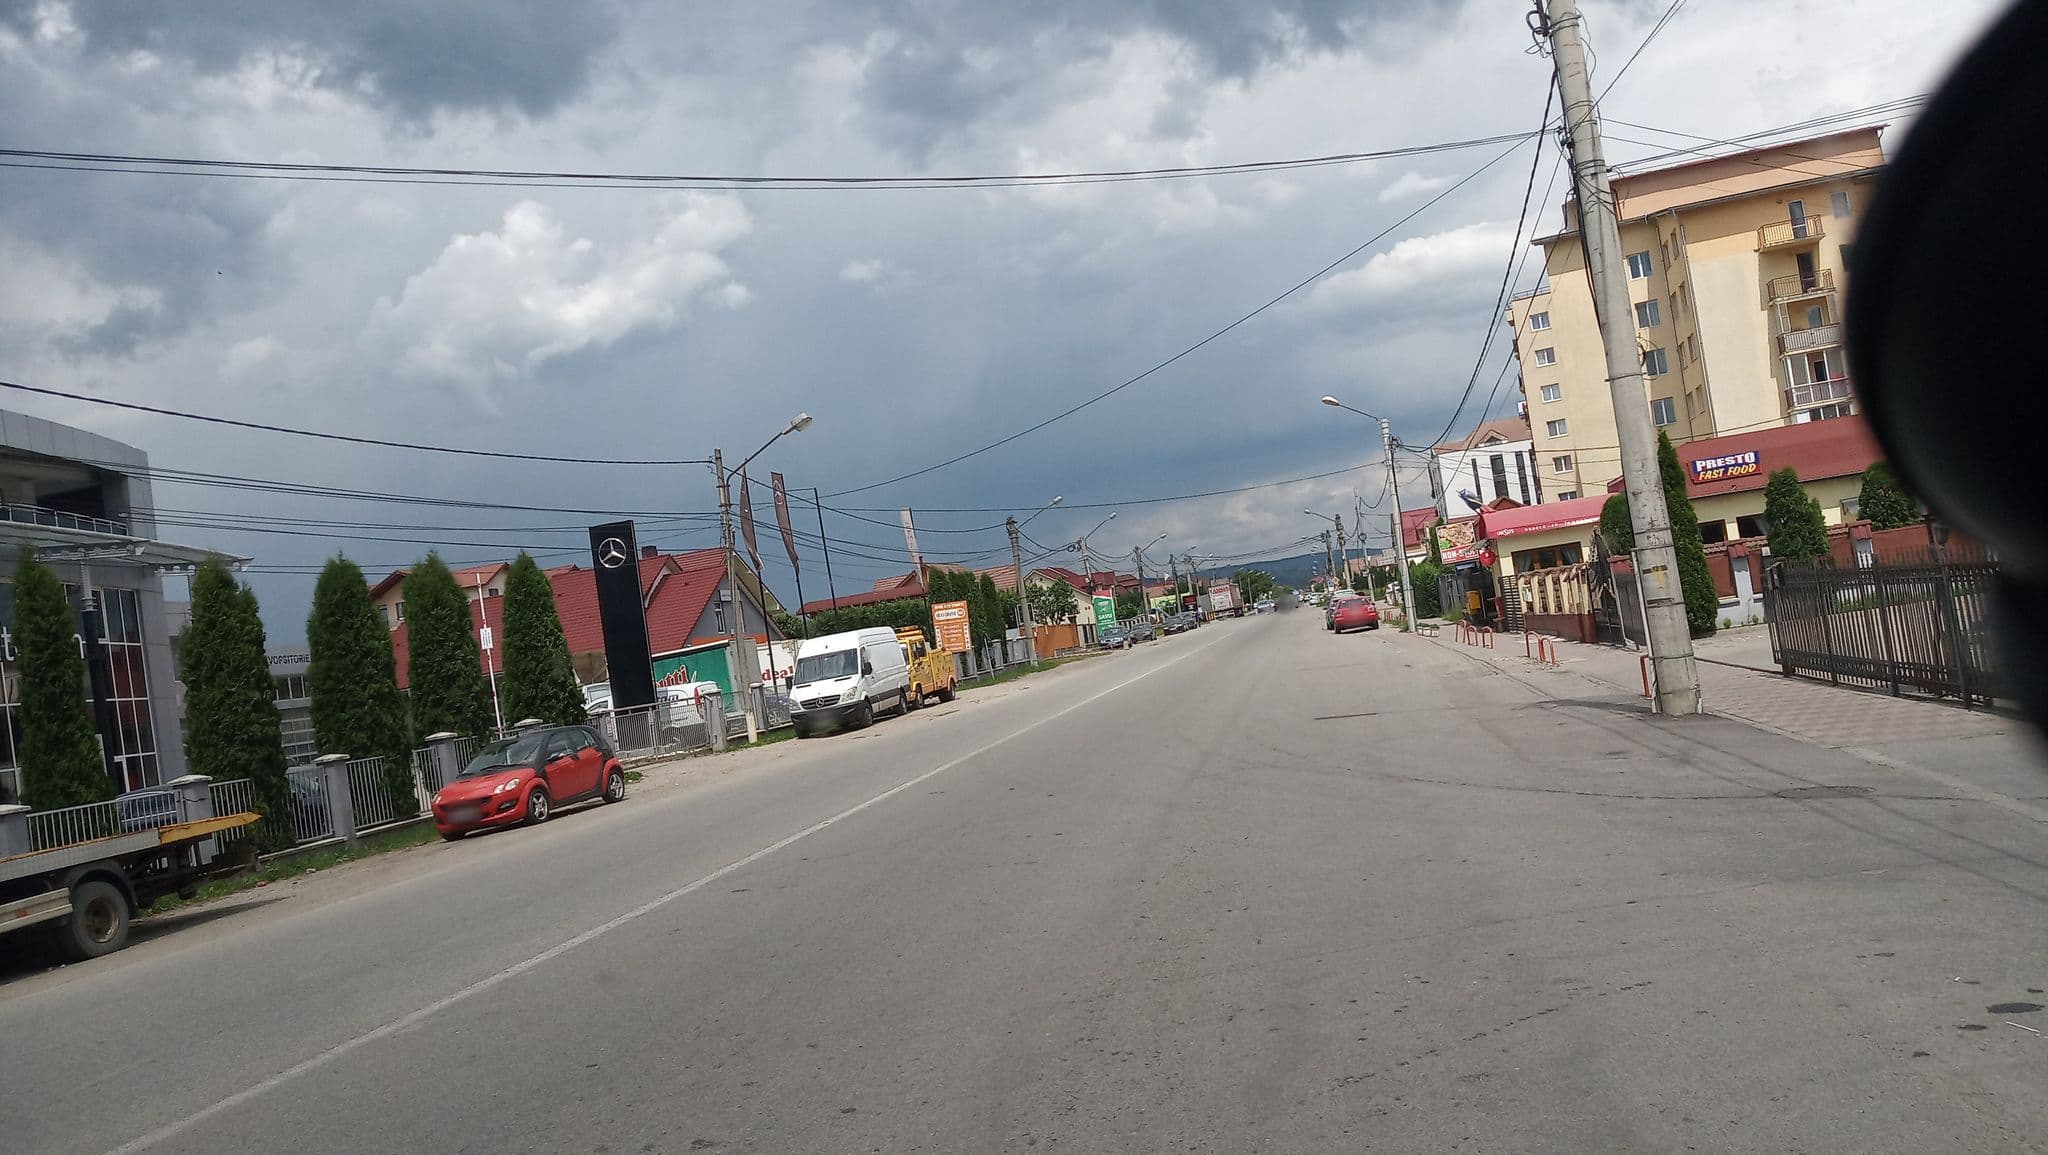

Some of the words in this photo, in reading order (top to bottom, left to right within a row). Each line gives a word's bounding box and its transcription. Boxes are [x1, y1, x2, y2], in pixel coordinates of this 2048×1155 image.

[1695, 452, 1756, 472] PRESTO
[1698, 468, 1726, 481] FAST
[1727, 463, 1757, 476] FOOD
[266, 654, 311, 665] VOPSITORIE
